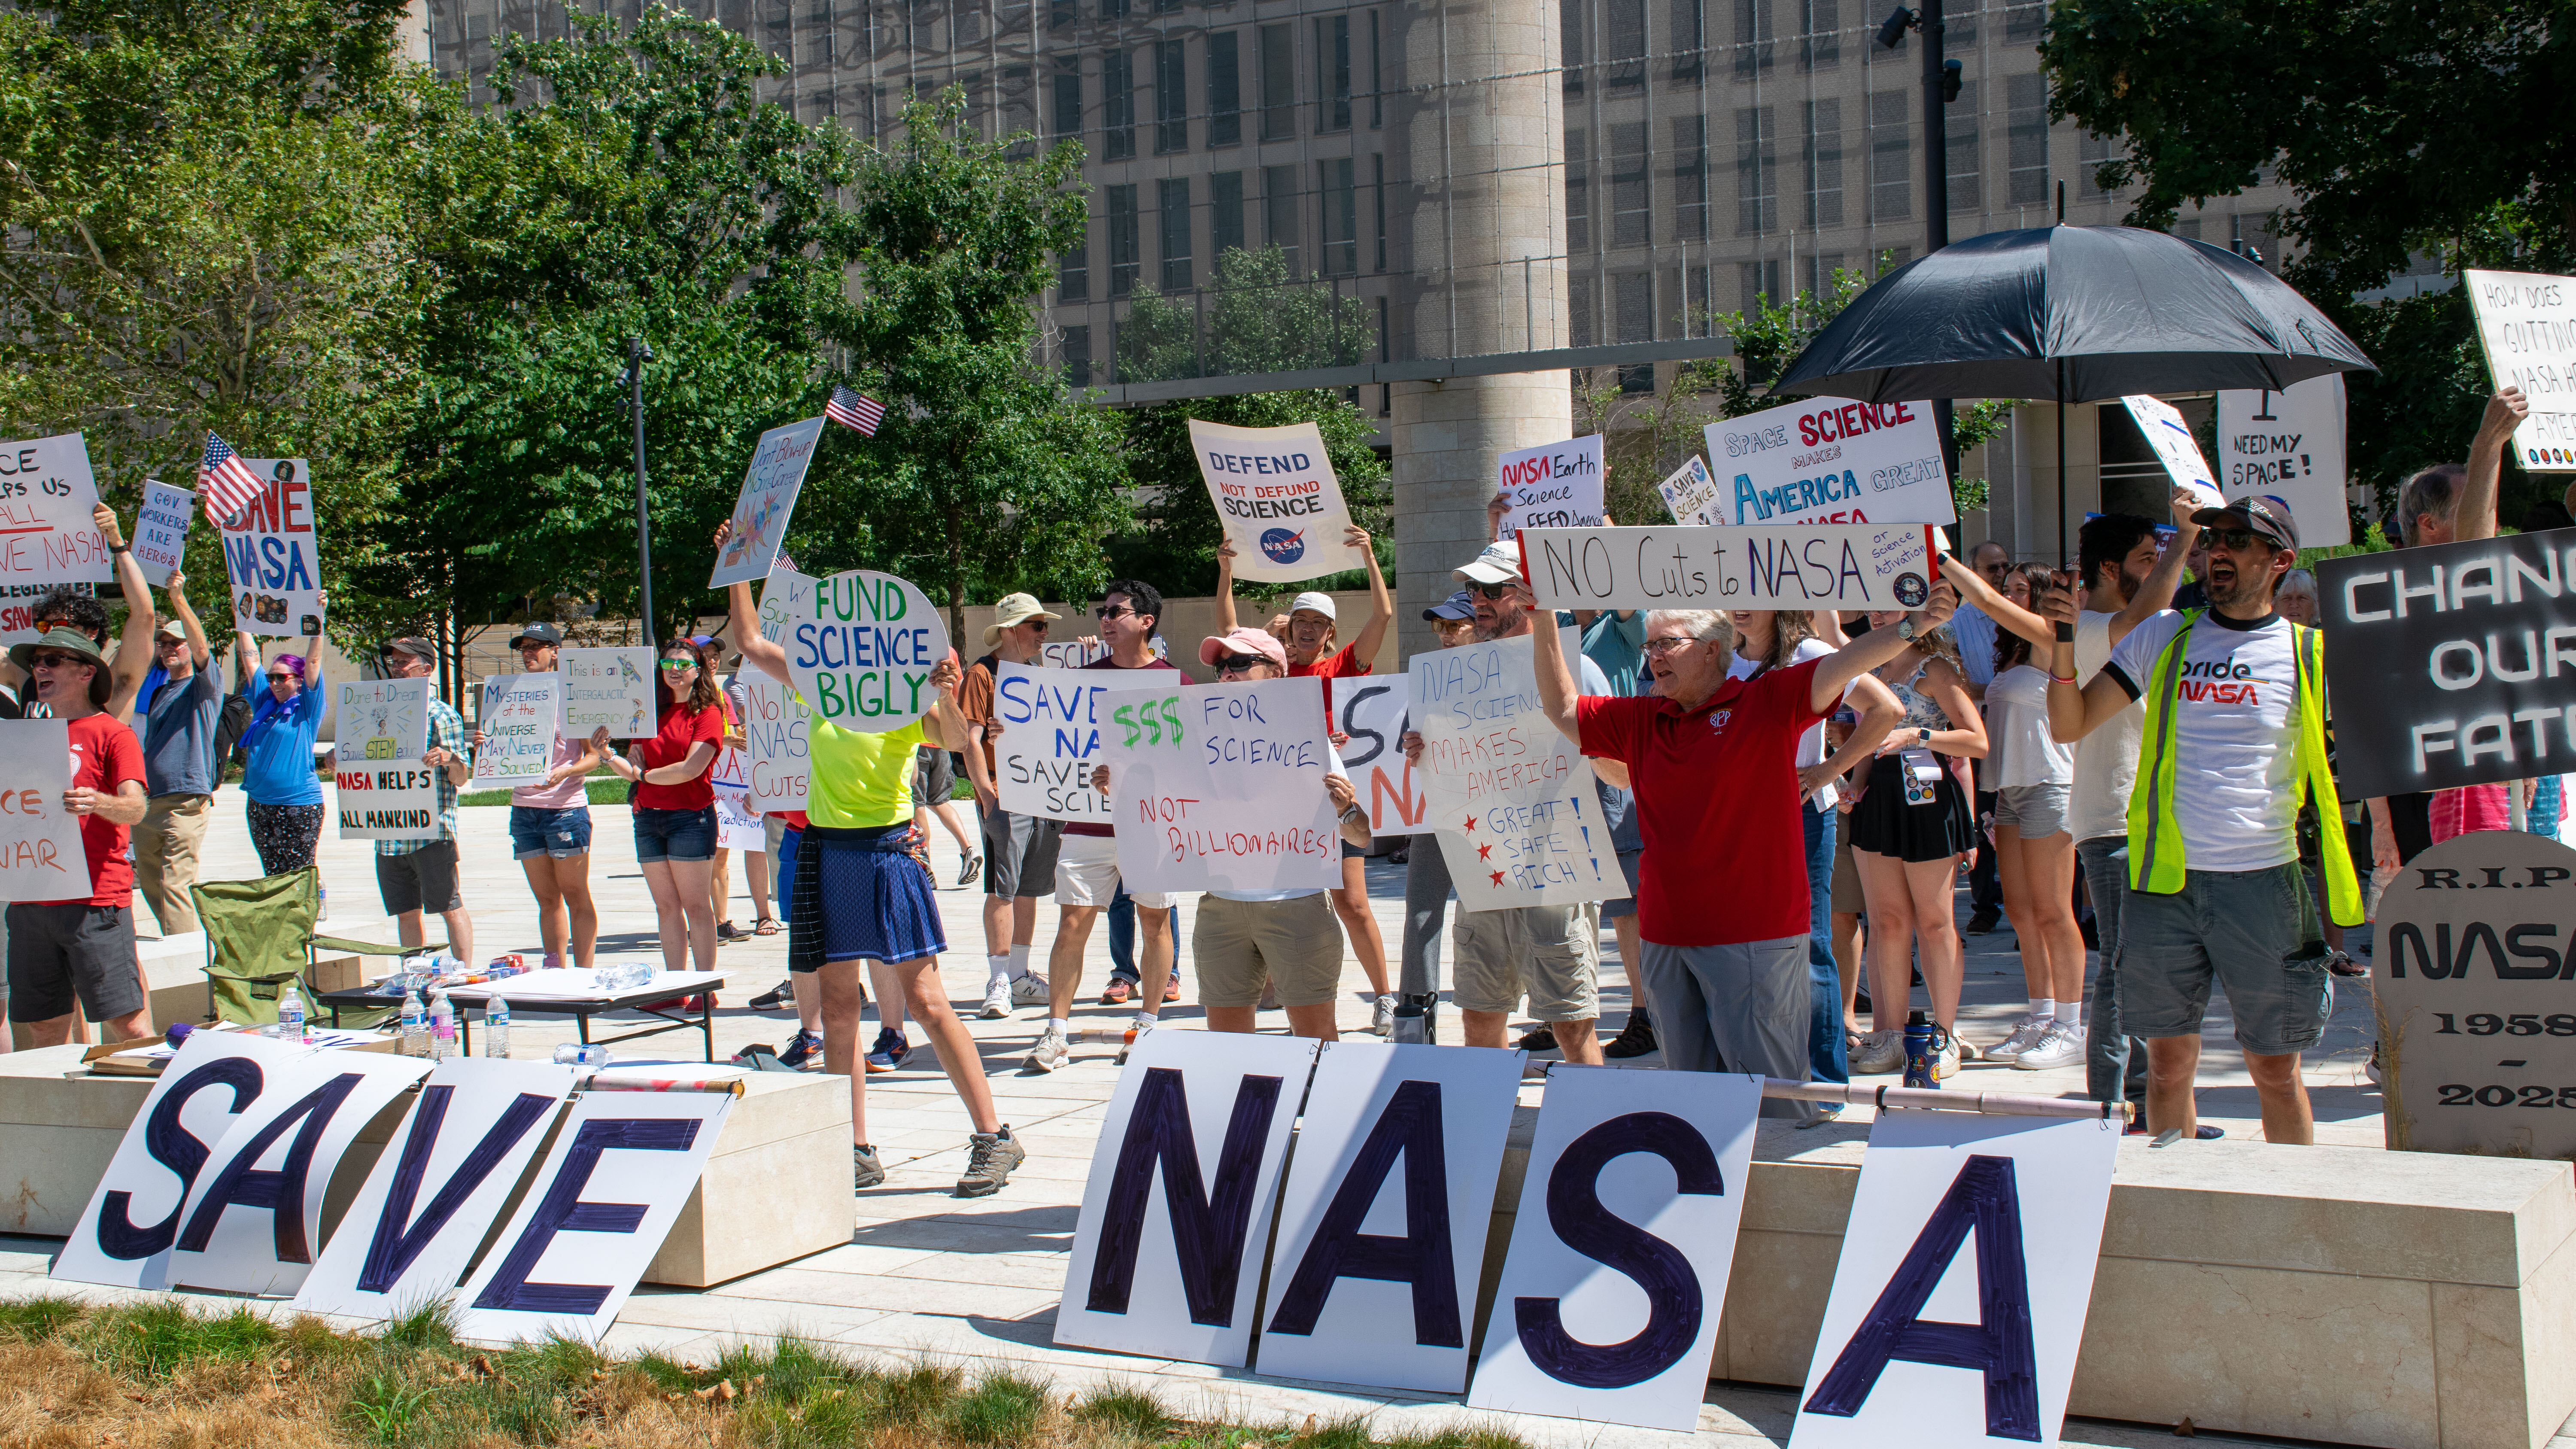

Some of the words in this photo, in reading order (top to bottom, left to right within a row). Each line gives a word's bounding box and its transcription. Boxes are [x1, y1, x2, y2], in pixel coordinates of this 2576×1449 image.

[2483, 283, 2518, 308] HOW
[2526, 284, 2562, 309] DOES
[2512, 364, 2563, 394] NASA
[2251, 389, 2277, 421] I
[1724, 425, 1789, 457] SPACE
[1798, 401, 1915, 447] SCIENCE
[1791, 445, 1841, 469] MAKES
[2234, 434, 2267, 455] NEED
[2270, 434, 2302, 453] MY
[1209, 452, 1310, 474] DEFEND
[1503, 456, 1550, 486] NASA
[1554, 452, 1595, 479] Earth
[2233, 454, 2311, 486] SPACE!
[42, 477, 71, 497] US
[1220, 482, 1246, 497] NOT
[1255, 481, 1320, 498] DEFUND
[1515, 486, 1573, 507] Science
[1673, 471, 1696, 496] SAVE
[1686, 489, 1695, 498] OUR
[1734, 470, 1861, 525] AMERICA
[1870, 456, 1941, 492] GREAT
[155, 492, 180, 510] GOV.
[1223, 495, 1324, 519] SCIENCE
[1677, 486, 1715, 520] SCIENCE
[140, 507, 188, 531] WORKERS
[1500, 522, 1517, 540] Hel
[1572, 510, 1603, 527] America
[146, 529, 172, 546] ARE
[1264, 541, 1302, 551] NASA
[1874, 531, 1888, 543] or
[43, 532, 108, 571] NASA!
[138, 545, 176, 567] HEROS
[224, 535, 313, 591] NASA
[1875, 545, 1926, 577] Activation
[1543, 536, 1613, 598] NO
[1638, 535, 1707, 598] Cuts
[1713, 540, 1738, 596] to
[1748, 538, 1870, 601] NASA
[816, 575, 907, 621] FUND
[2344, 550, 2576, 623] CHAN
[796, 624, 931, 669] SCIENCE
[566, 659, 587, 676] This
[592, 664, 601, 676] is
[607, 667, 618, 675] an
[1422, 650, 1501, 704] NASA
[345, 687, 371, 705] Dare
[374, 686, 385, 703] to
[388, 684, 419, 703] Dream
[566, 683, 627, 700] INTERGALACTIC
[817, 671, 928, 717] BIGLY
[1001, 676, 1108, 723] SAVE
[2178, 680, 2258, 705] NASA
[503, 704, 515, 716] of
[518, 703, 535, 715] the
[567, 708, 624, 724] EMERGENCY
[1113, 696, 1183, 751] $$$
[1205, 694, 1265, 725] FOR
[342, 743, 365, 761] Save
[366, 740, 396, 759] STEM
[397, 740, 417, 758] educ
[480, 738, 505, 756] MAY
[508, 737, 546, 755] NEVER
[751, 721, 810, 759] NAS
[1206, 736, 1318, 767] SCIENCE
[1432, 728, 1525, 774] MAKES
[2412, 706, 2576, 773] FAT
[478, 758, 495, 776] BE
[499, 756, 547, 775] SOLVED!
[1008, 755, 1091, 789] SAVE
[1469, 755, 1568, 799] AMERICA
[337, 772, 373, 790] NASA
[378, 770, 431, 790] HELPS
[340, 810, 364, 828] ALL
[366, 809, 431, 829] MANKIND
[1140, 796, 1200, 823] NOT
[1168, 827, 1336, 862] BILLIONAIRES!
[2432, 1013, 2576, 1036] 1958
[98, 1057, 703, 1315] SAVE
[1085, 1067, 2042, 1441] NASA
